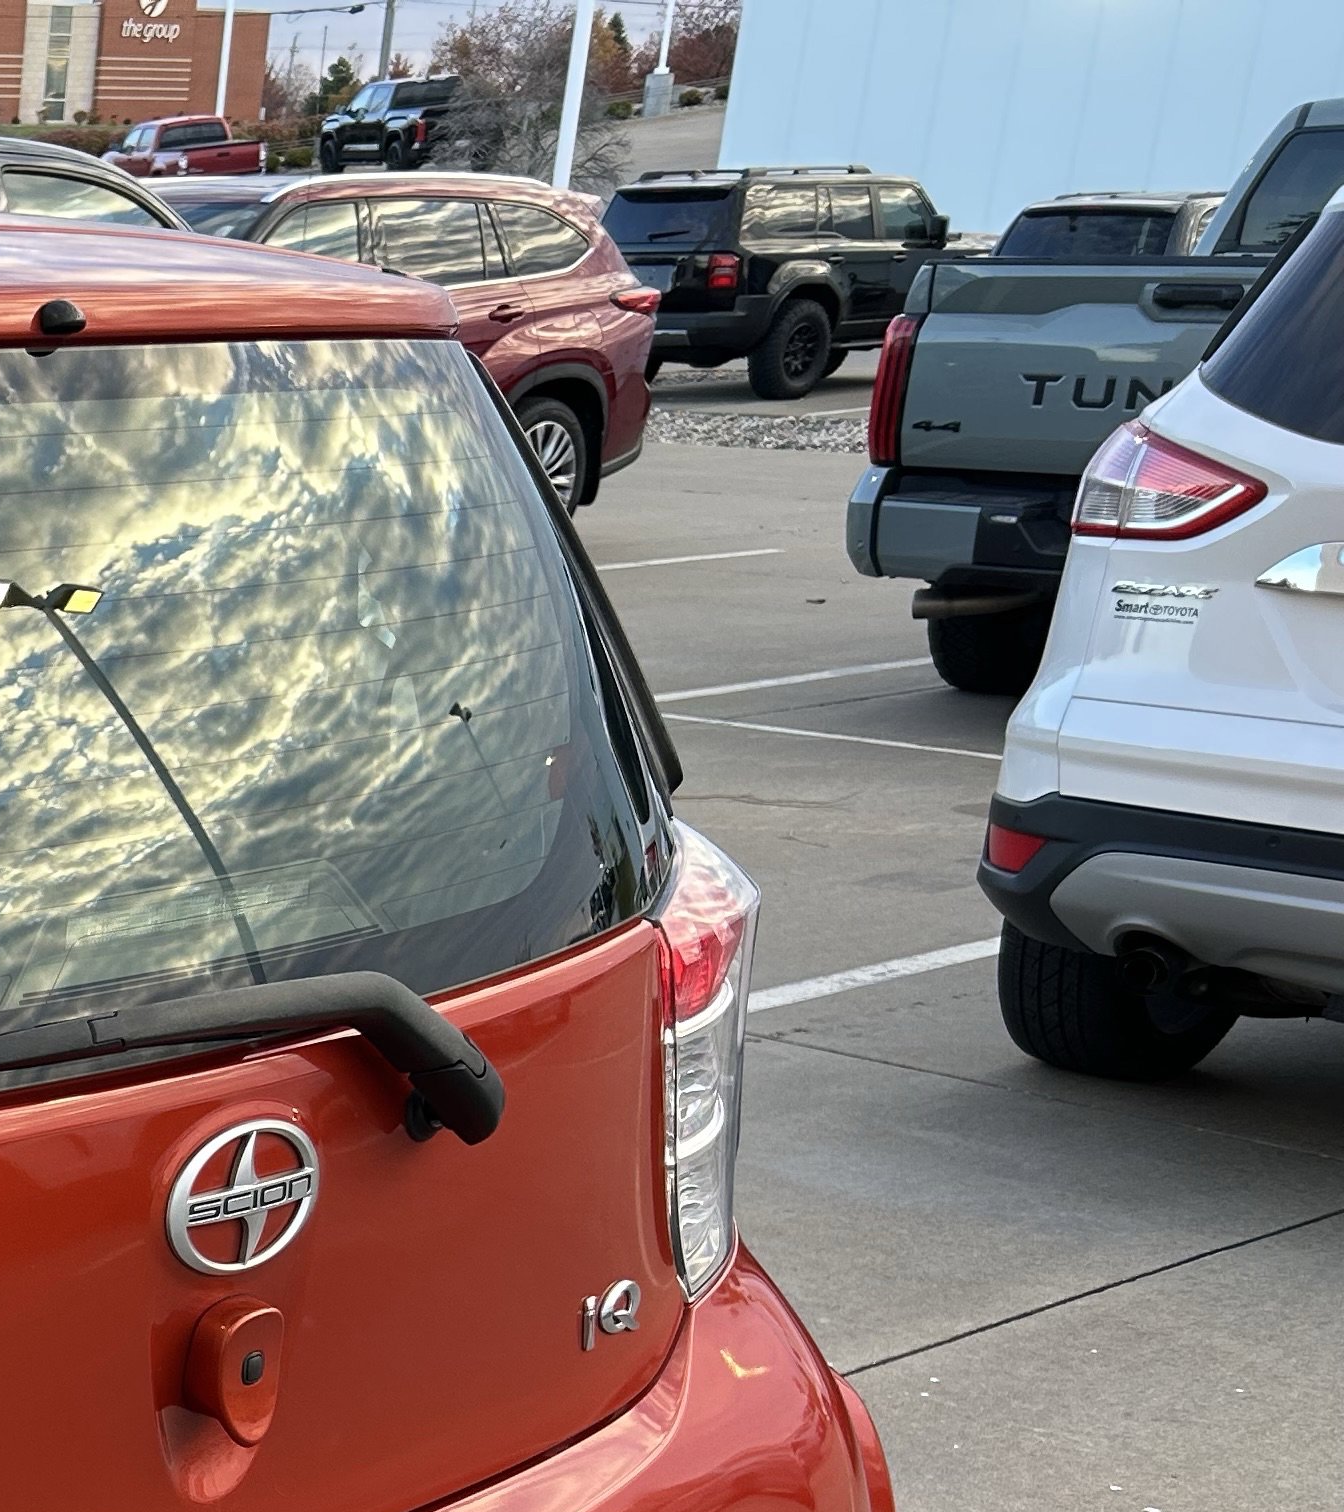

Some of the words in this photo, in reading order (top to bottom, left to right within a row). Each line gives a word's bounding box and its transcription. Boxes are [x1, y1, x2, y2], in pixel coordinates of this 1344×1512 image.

[121, 18, 143, 37] the
[142, 23, 180, 43] group
[1114, 599, 1150, 614] Smart
[1163, 605, 1199, 618] TOYOTA
[188, 1173, 311, 1222] SCION
